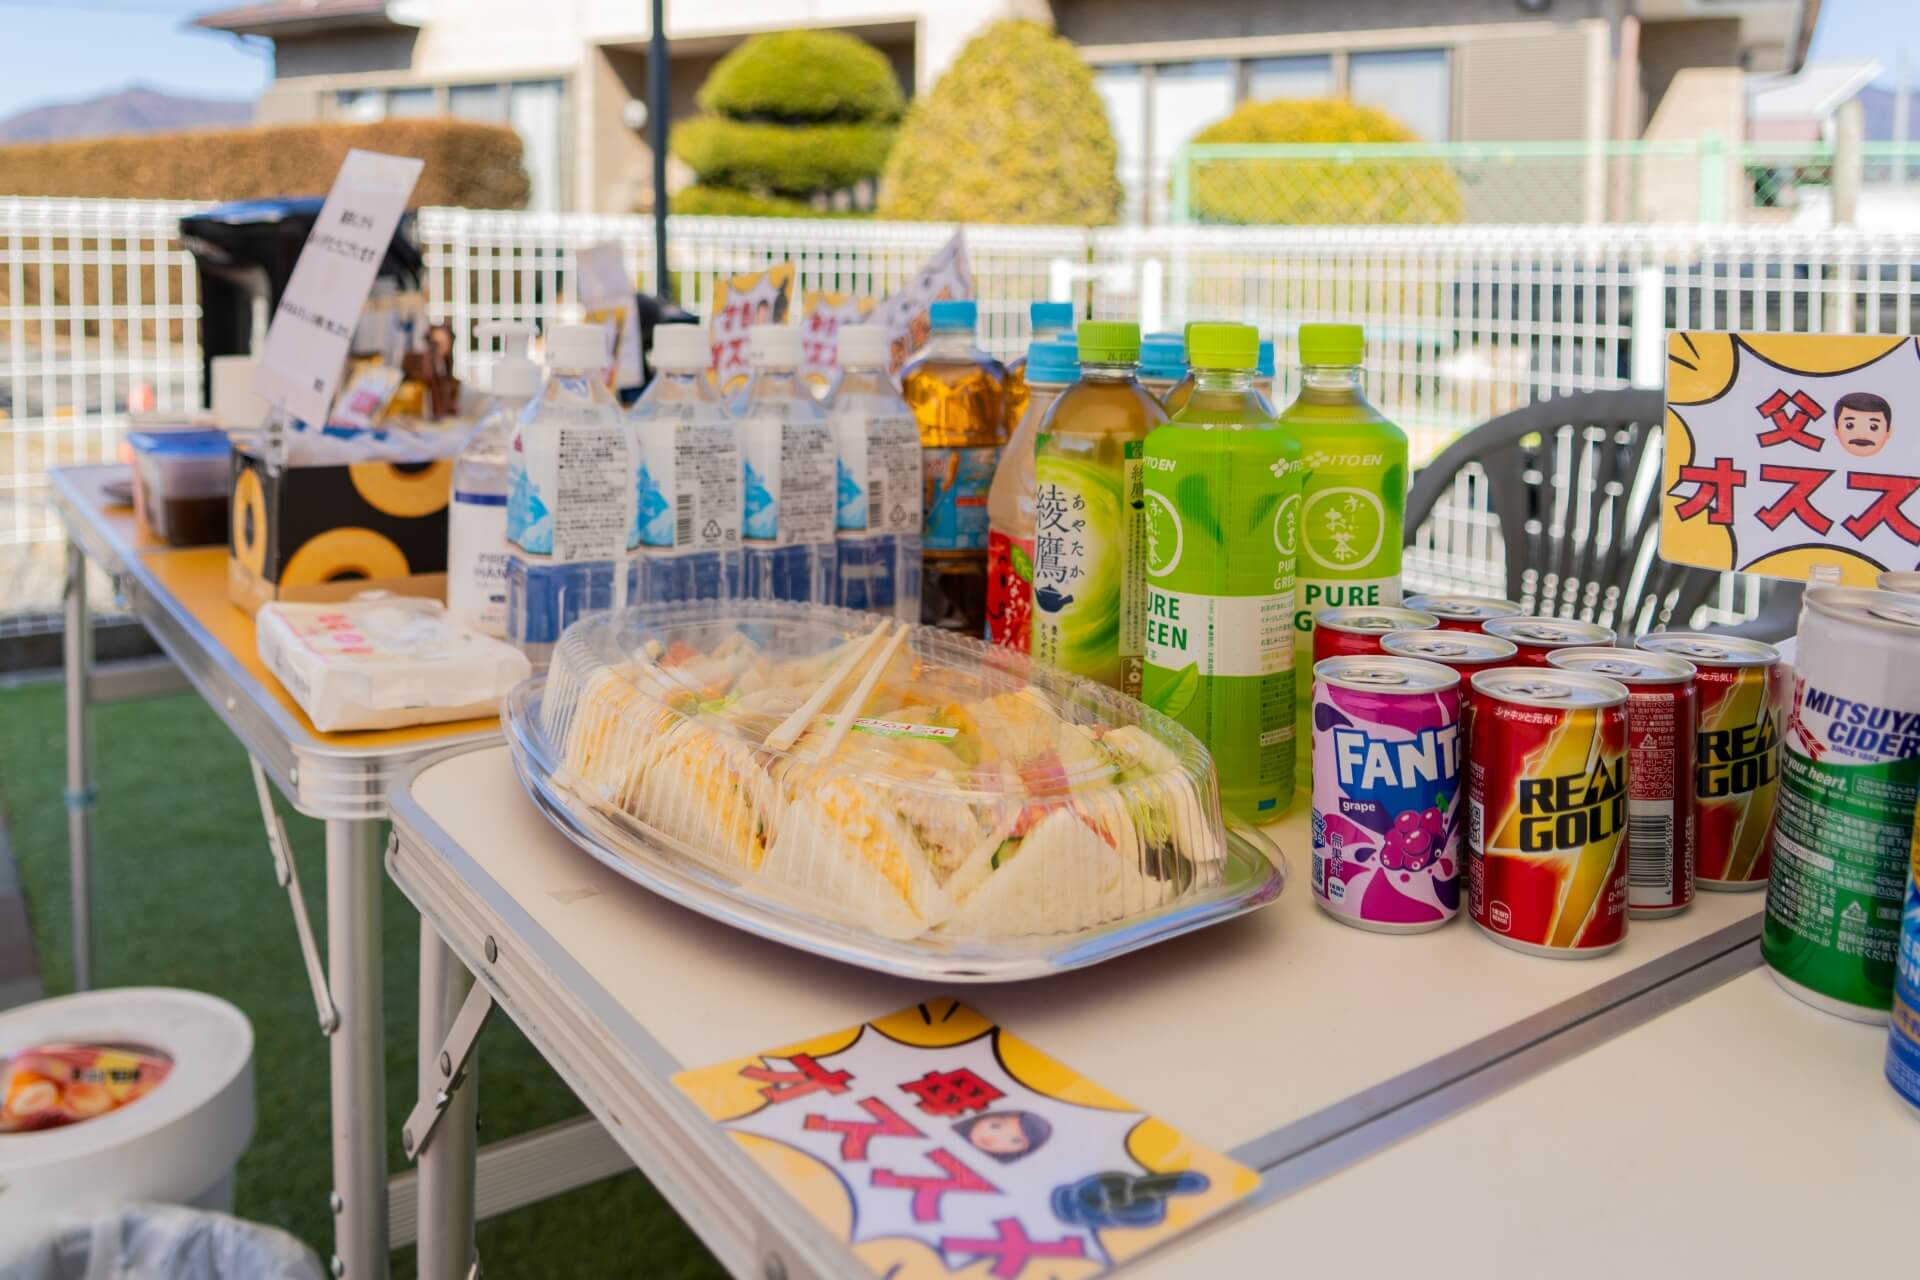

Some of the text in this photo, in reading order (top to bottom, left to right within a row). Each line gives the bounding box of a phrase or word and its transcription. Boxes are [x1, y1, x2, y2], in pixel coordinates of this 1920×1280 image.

[1755, 388, 1827, 453] 父
[1036, 484, 1070, 584] 綾鷹
[1070, 494, 1086, 579] あやたか
[1306, 585, 1380, 607] PURE
[1805, 687, 1920, 736] MITSUYA
[1336, 727, 1460, 789] FANT
[1828, 722, 1920, 759] CIDER
[1788, 757, 1807, 775] your
[1808, 766, 1848, 792] heart.
[1343, 800, 1376, 813] grape
[899, 1066, 1006, 1117] 母
